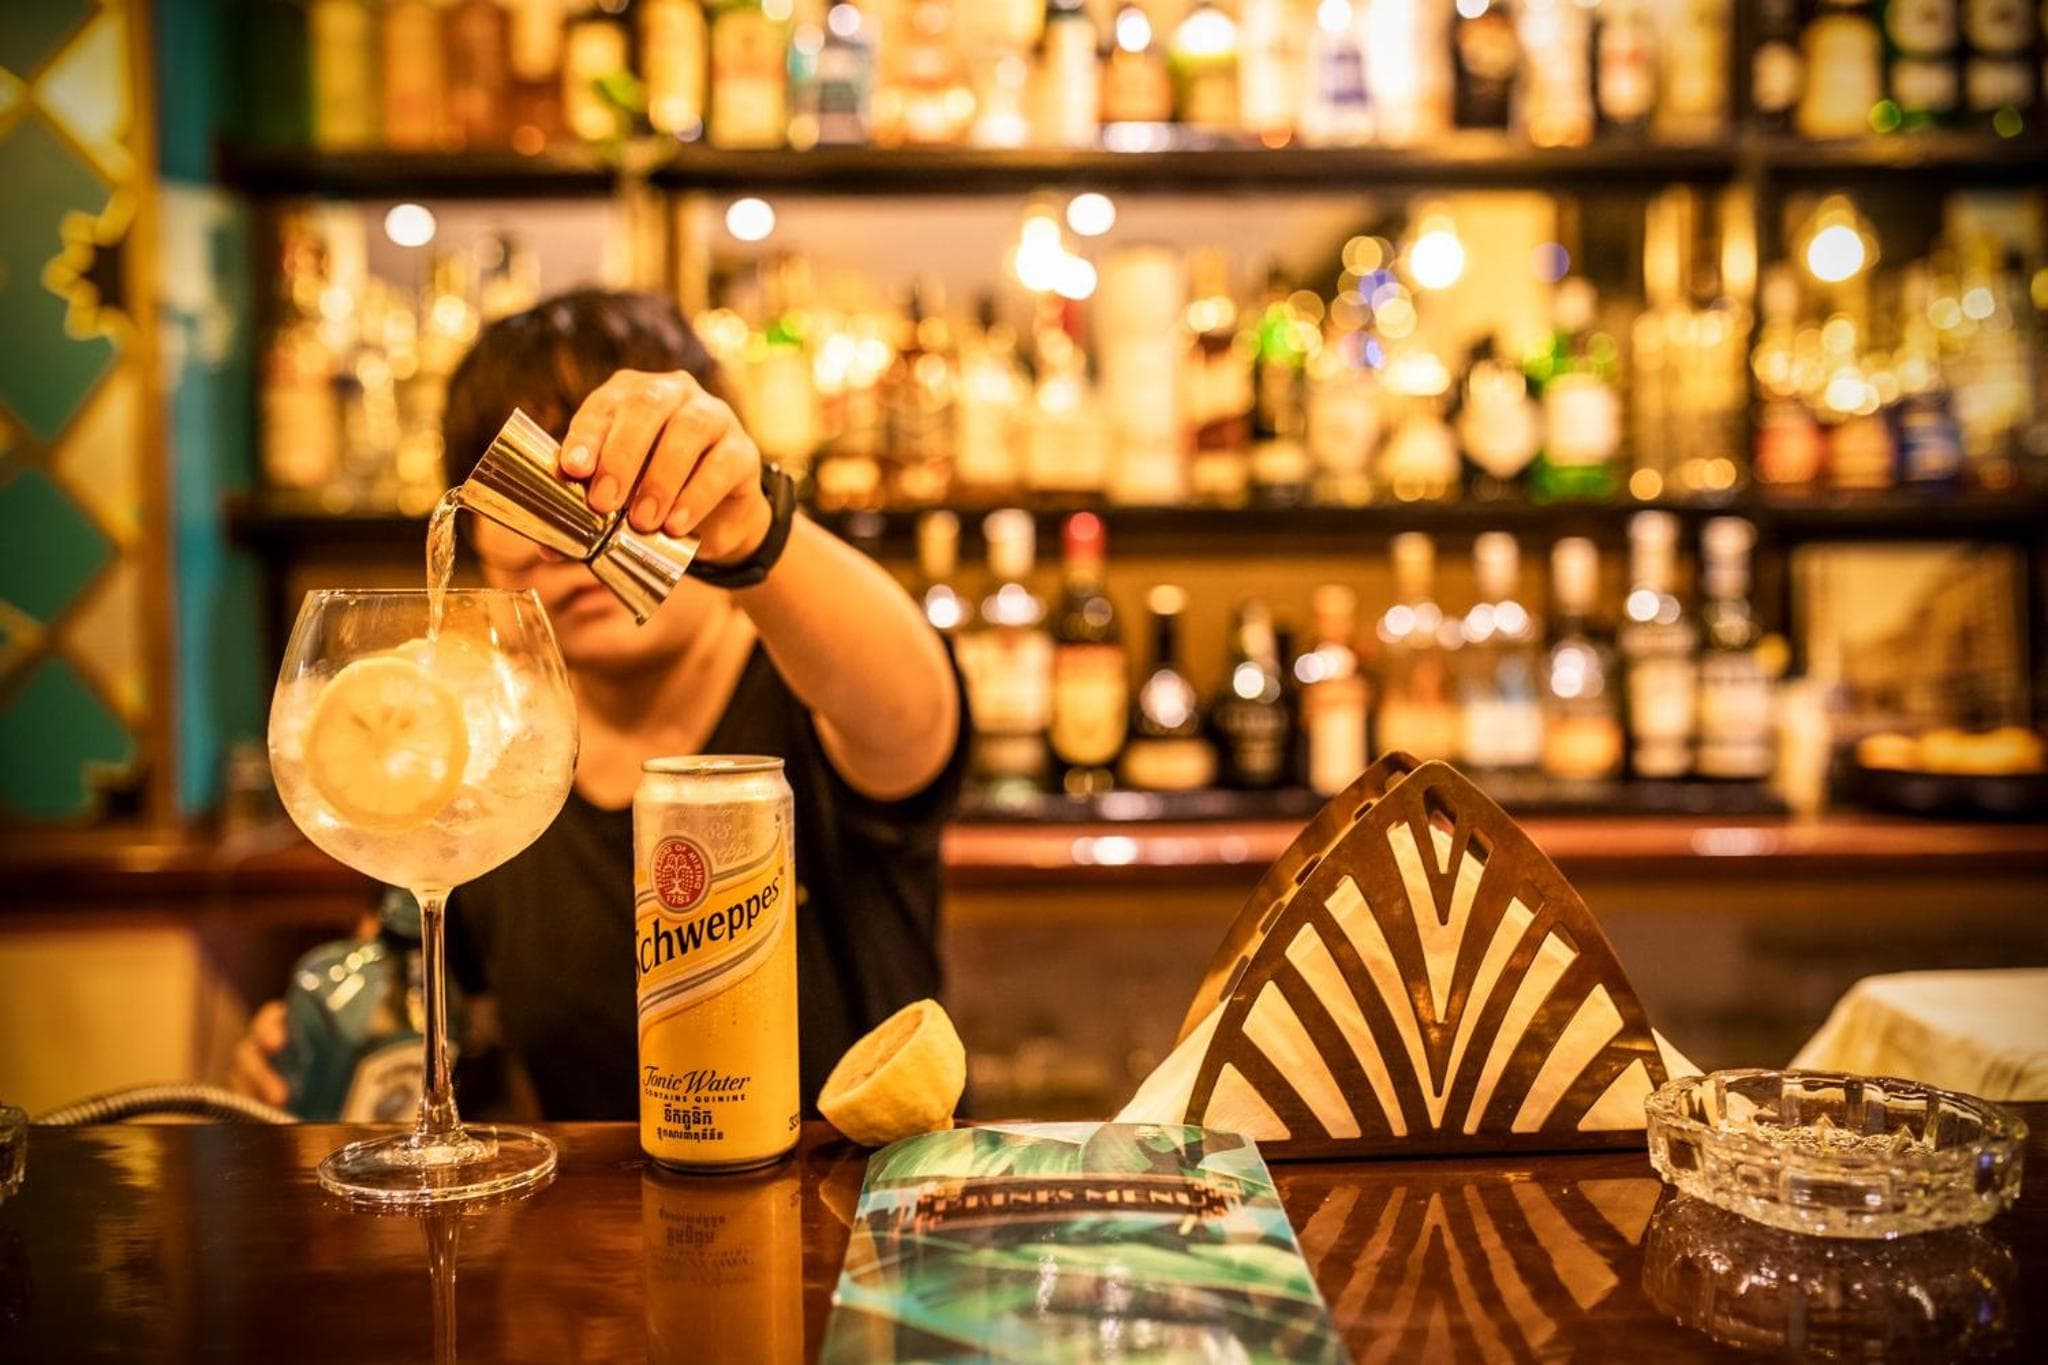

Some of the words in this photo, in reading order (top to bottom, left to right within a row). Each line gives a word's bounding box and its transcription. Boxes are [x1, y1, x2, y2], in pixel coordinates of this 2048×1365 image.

[643, 1065, 683, 1091] Tonic
[683, 1070, 747, 1095] Water
[695, 1093, 746, 1103] QUININE
[1085, 1188, 1208, 1207] MENU
